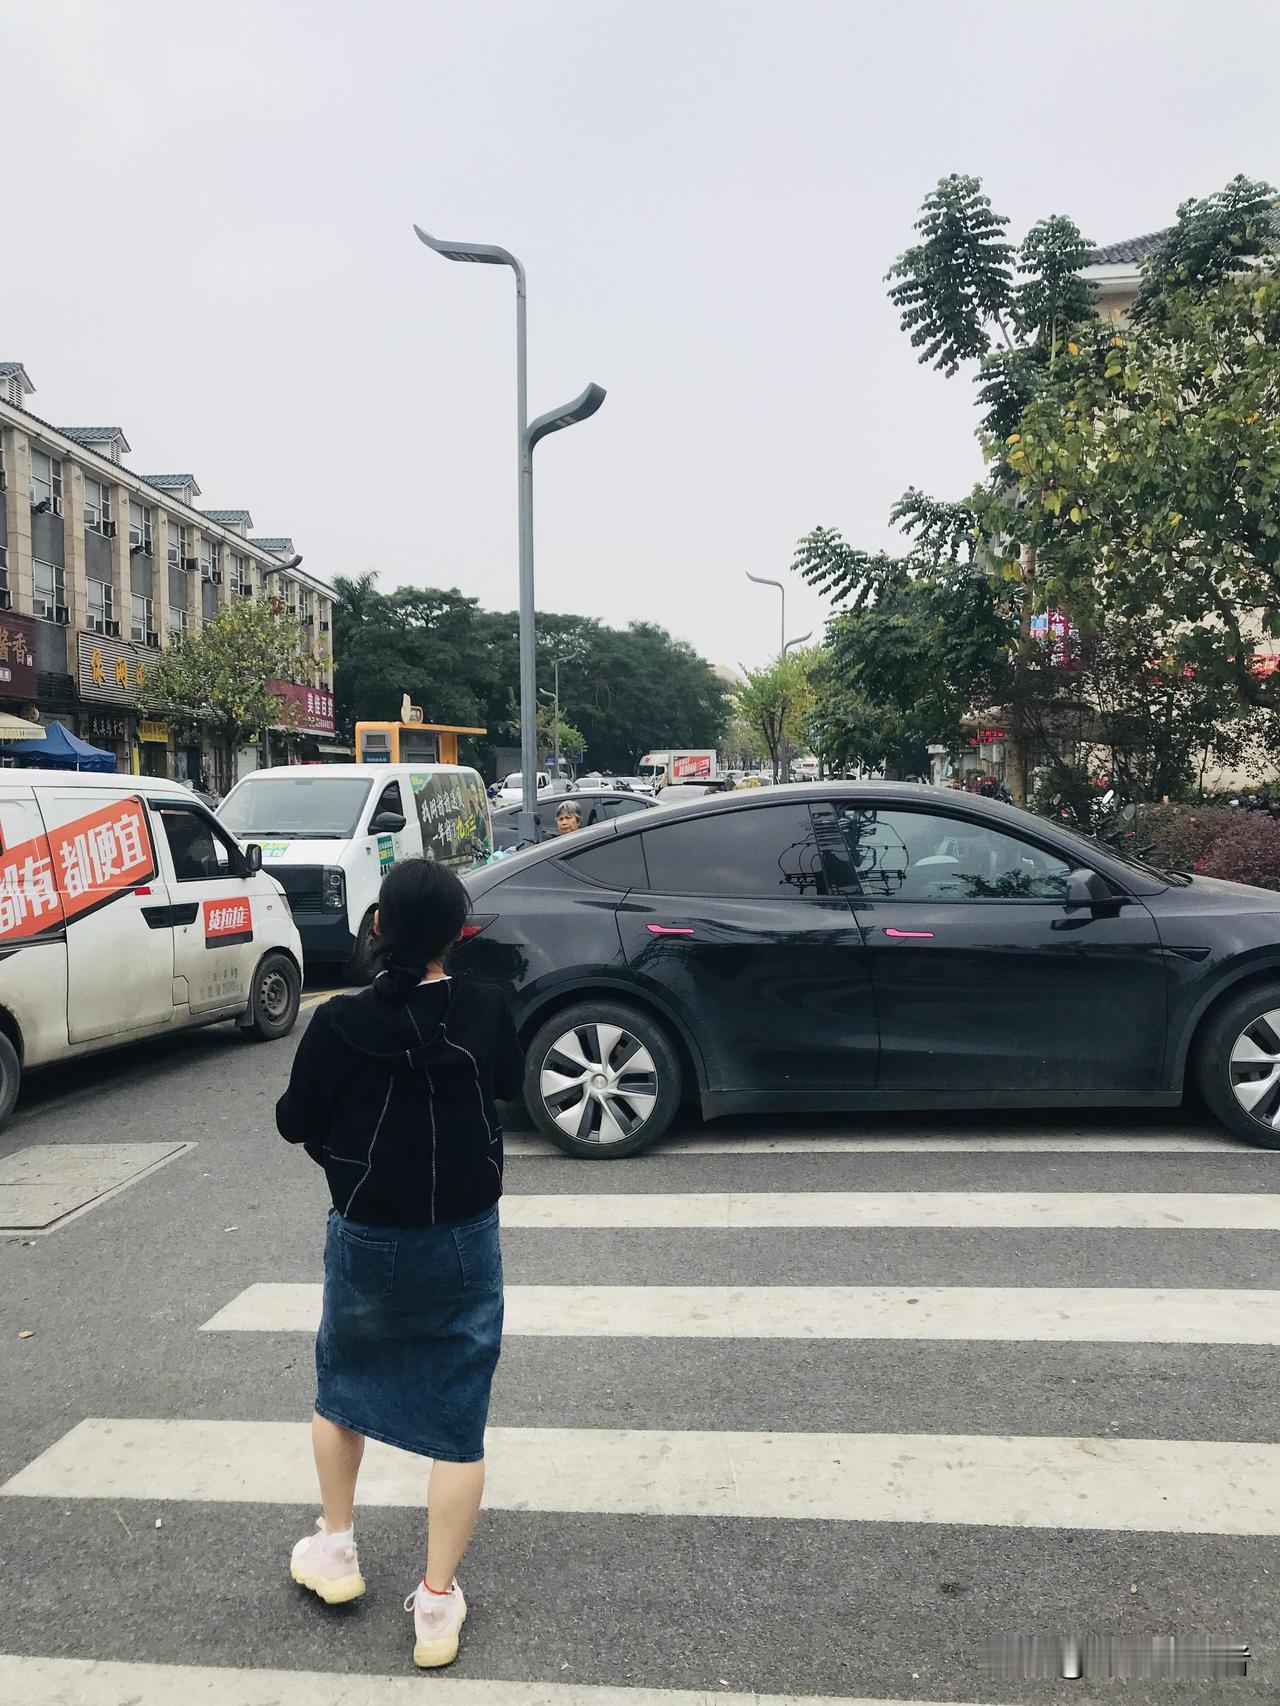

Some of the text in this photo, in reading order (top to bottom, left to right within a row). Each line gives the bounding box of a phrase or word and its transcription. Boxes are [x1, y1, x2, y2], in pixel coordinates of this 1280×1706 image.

[0, 813, 147, 931] 都有 都便宜
[208, 906, 249, 931] 货拉拉
